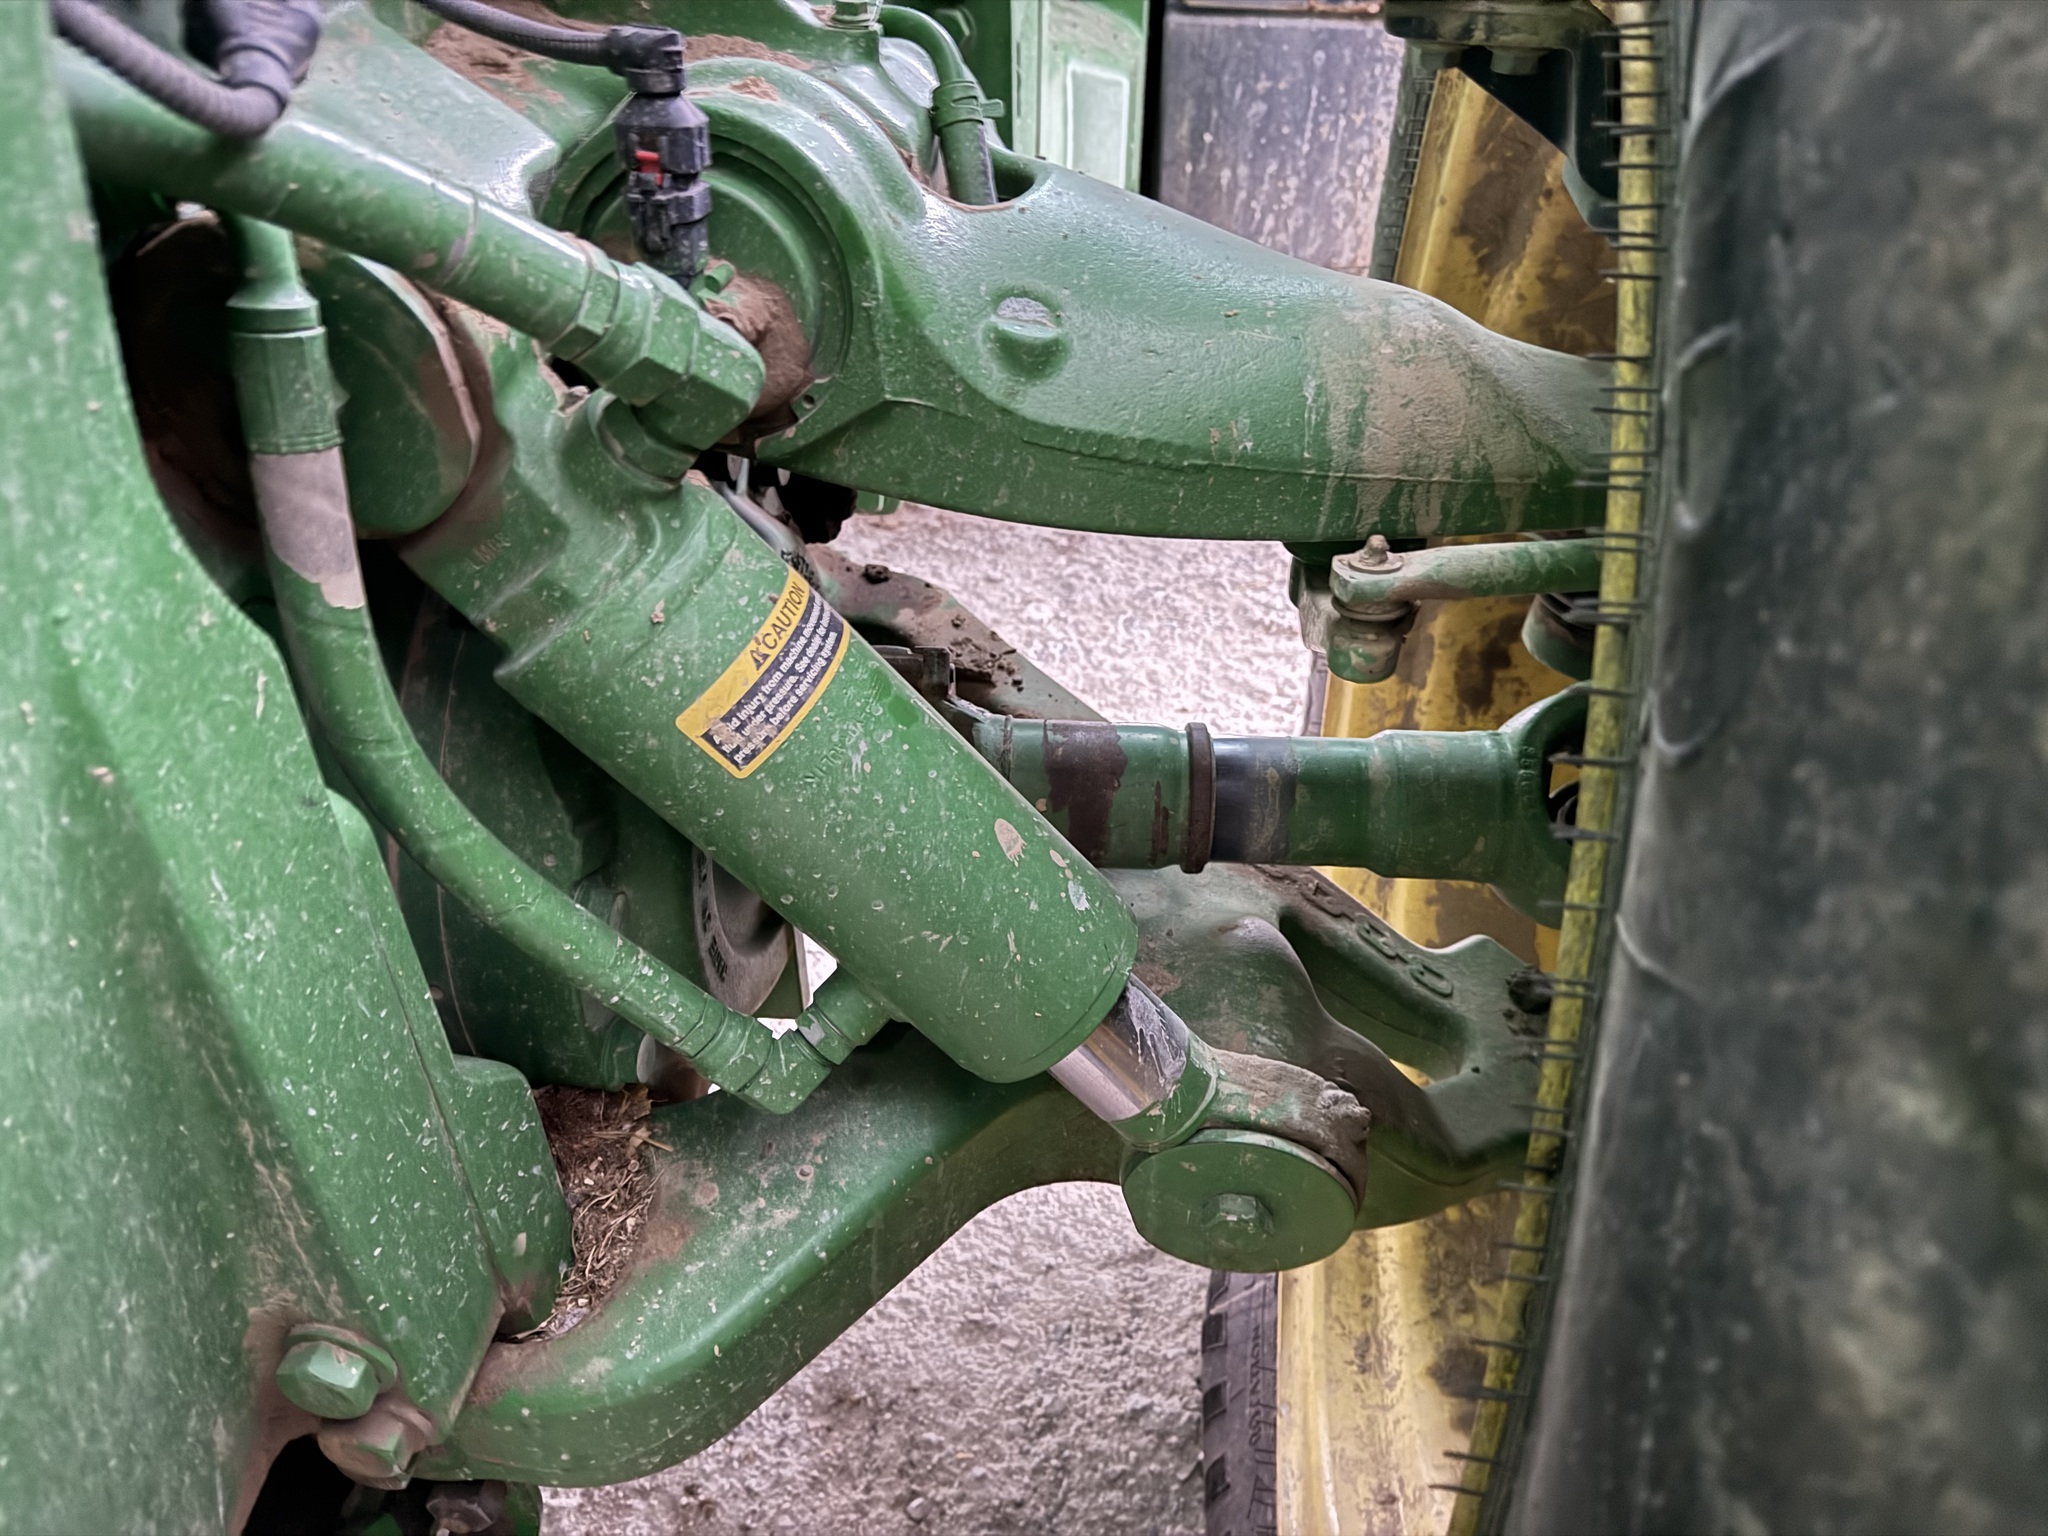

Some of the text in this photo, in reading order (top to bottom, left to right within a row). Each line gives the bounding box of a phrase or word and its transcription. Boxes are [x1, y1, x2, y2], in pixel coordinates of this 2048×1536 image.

[762, 580, 805, 649] CAUTION
[712, 716, 740, 745] Aoid
[736, 688, 766, 721] injury
[760, 669, 784, 694] from
[779, 633, 808, 674] machine
[763, 672, 799, 715] pressure.
[794, 653, 811, 673] See
[768, 692, 799, 726] before
[794, 654, 826, 697] servicing
